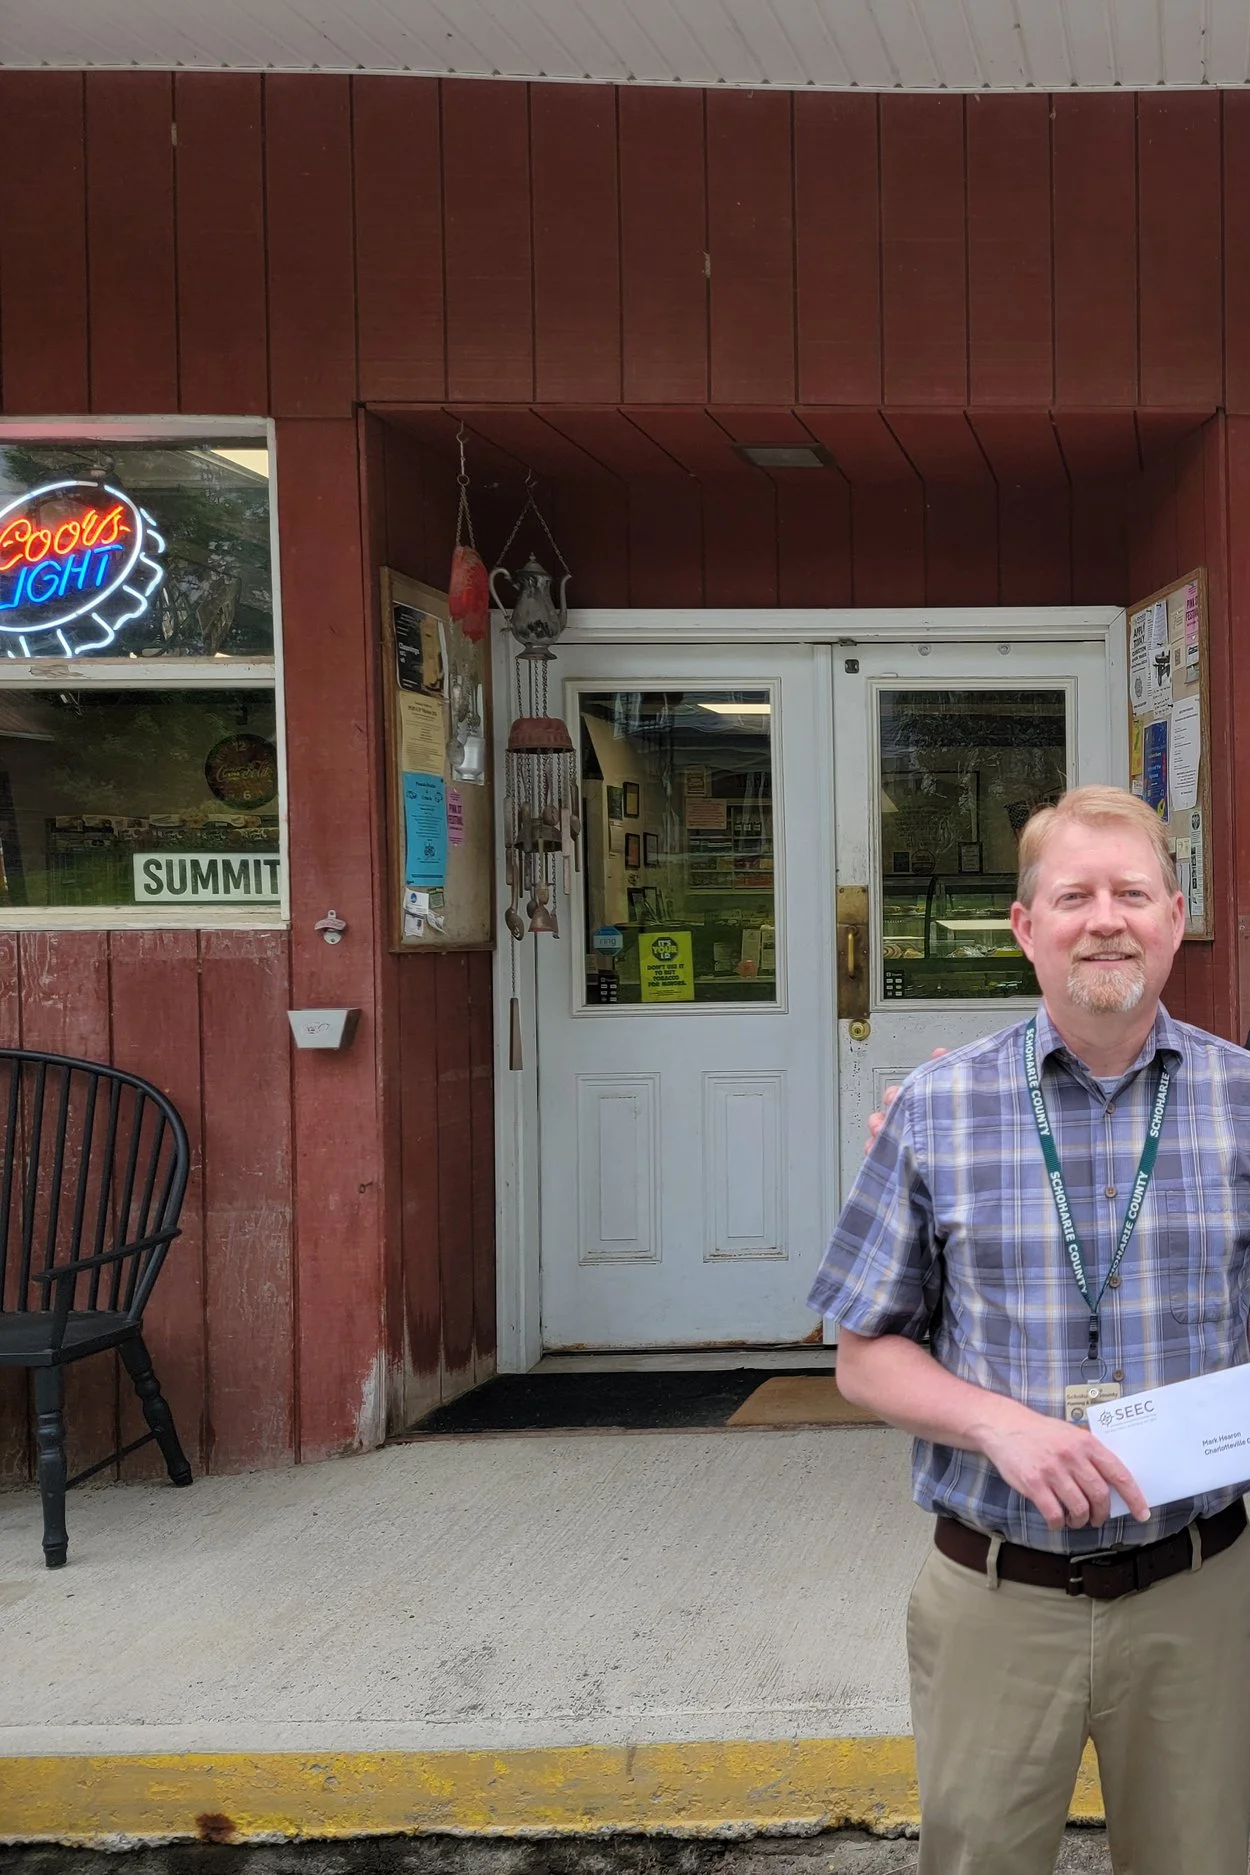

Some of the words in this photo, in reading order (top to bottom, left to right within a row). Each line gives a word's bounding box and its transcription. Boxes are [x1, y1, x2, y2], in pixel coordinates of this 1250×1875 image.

[0, 505, 131, 570] Coors
[143, 858, 280, 895] SUMMIT
[599, 938, 616, 946] ring
[1025, 1027, 1040, 1089] SCHOHARIE
[1031, 1090, 1050, 1137] COUNTY
[1150, 1072, 1170, 1137] SCHOHARIE
[1128, 1170, 1149, 1220] COUNTY
[1050, 1171, 1076, 1243] SCHOHARIE
[1069, 1243, 1088, 1295] COUNTY
[1115, 1400, 1155, 1420] SEEC
[1202, 1437, 1218, 1446] Mark
[1204, 1440, 1246, 1455] Charlotteville
